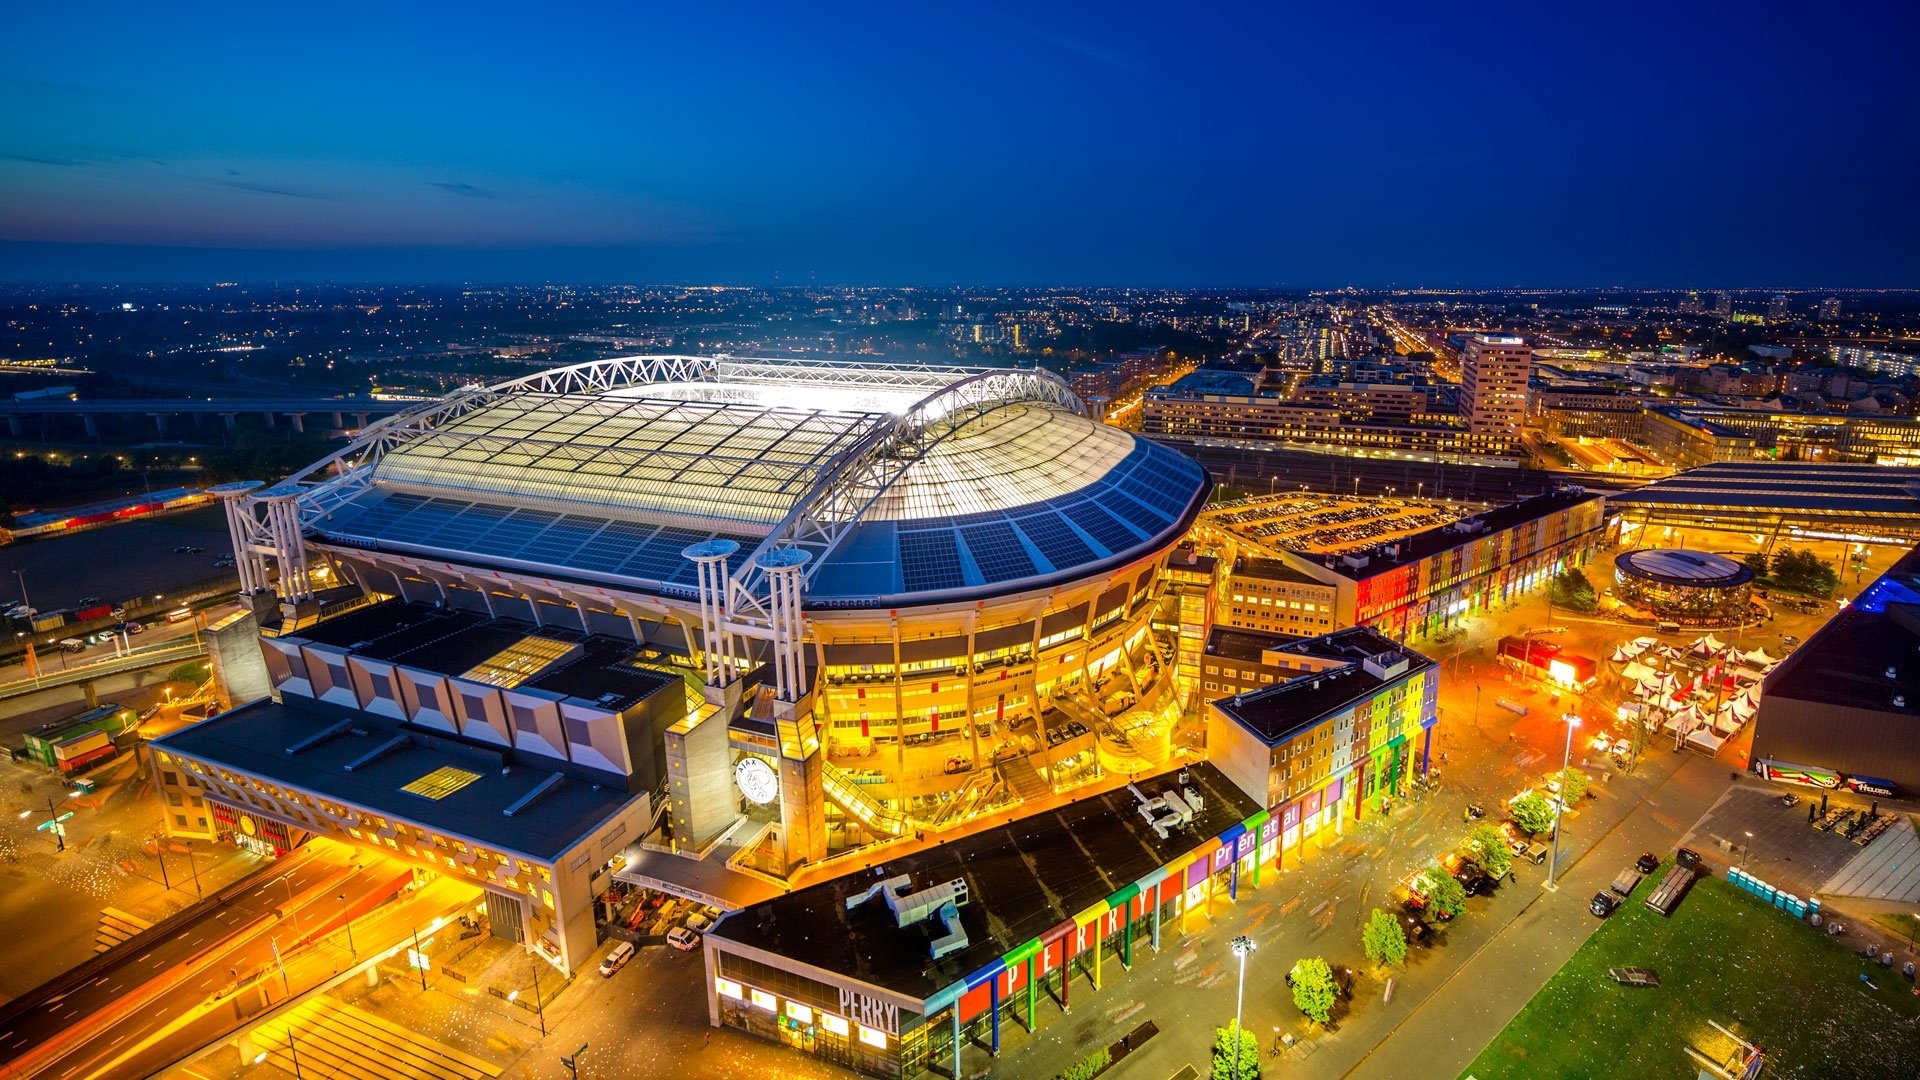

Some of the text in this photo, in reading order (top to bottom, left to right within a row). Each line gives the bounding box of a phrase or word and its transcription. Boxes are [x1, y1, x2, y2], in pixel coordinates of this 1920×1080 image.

[738, 759, 756, 773] AJAX
[1215, 806, 1296, 867] Prénatal
[1007, 888, 1147, 995] PERRY
[839, 987, 895, 1033] PERRY
